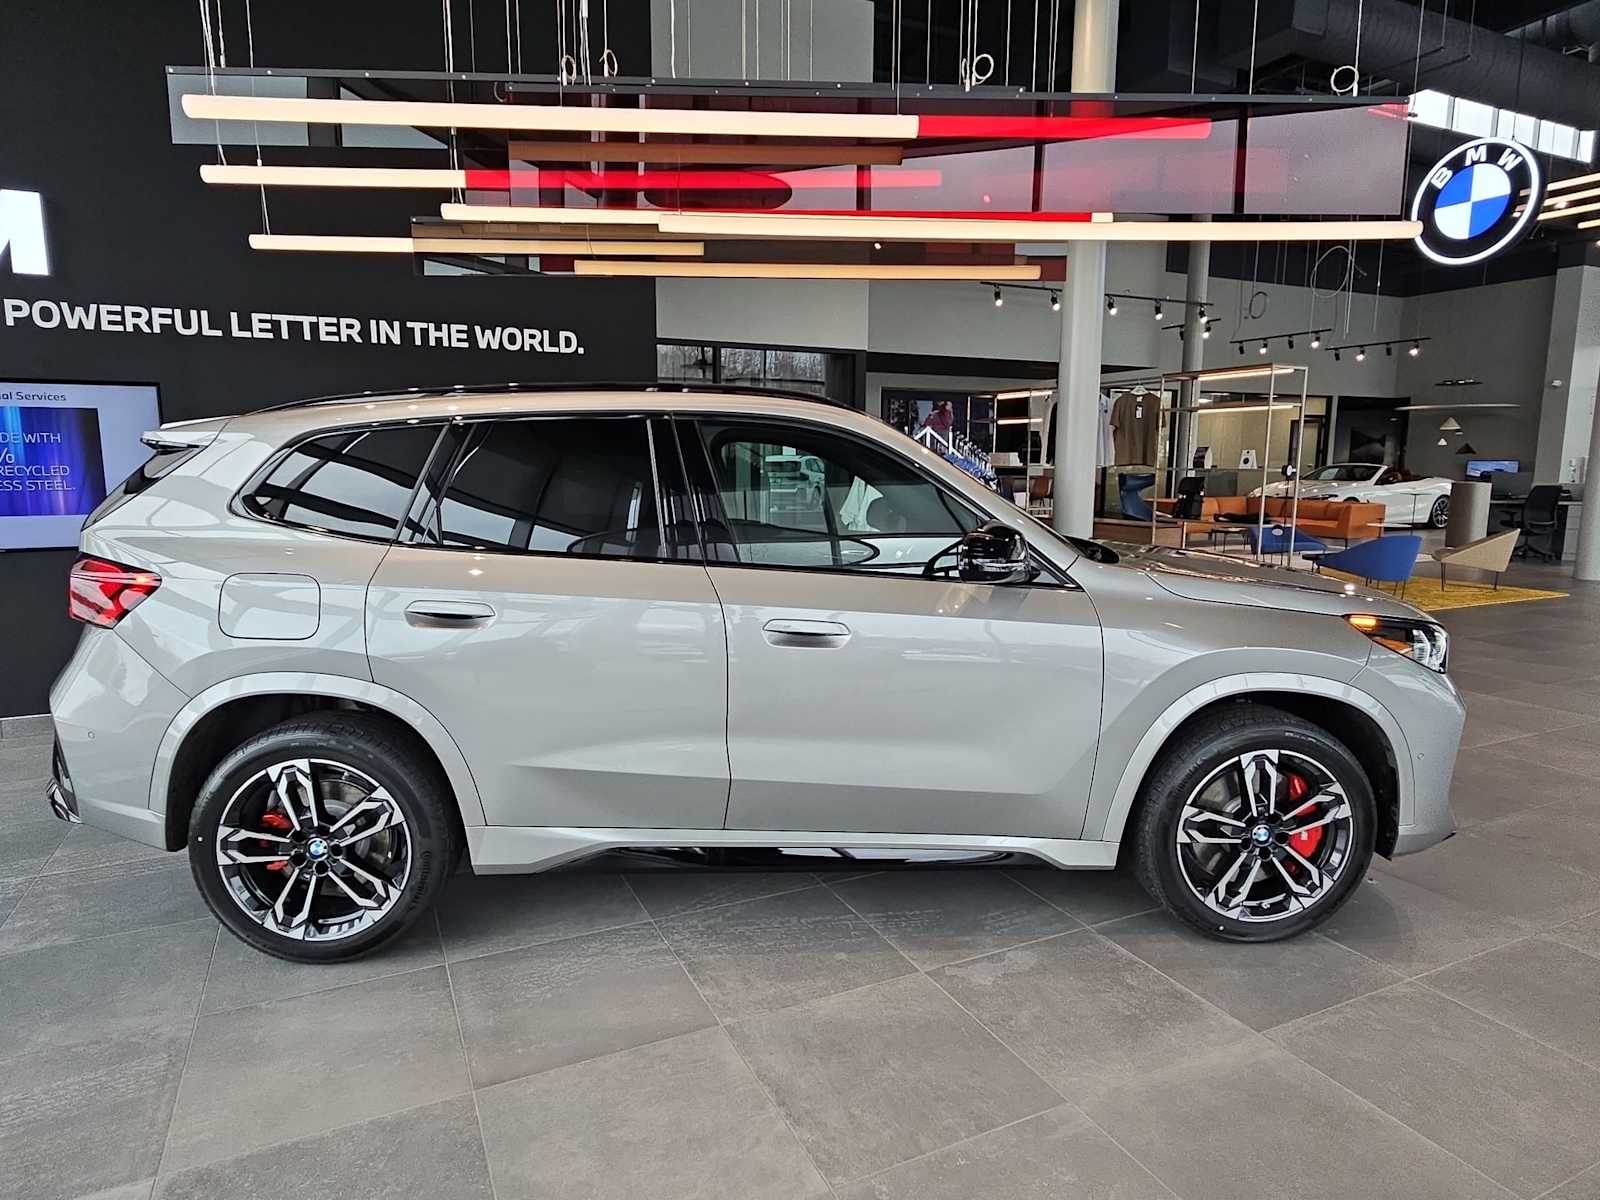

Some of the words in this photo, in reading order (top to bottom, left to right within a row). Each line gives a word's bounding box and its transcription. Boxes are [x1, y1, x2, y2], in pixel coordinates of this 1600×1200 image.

[1430, 145, 1523, 189] BMW
[4, 299, 223, 337] POWERFUL
[229, 311, 363, 343] LETTER
[370, 319, 400, 345] IN
[406, 322, 469, 348] THE
[474, 325, 585, 355] WORLD.
[0, 391, 13, 400] al
[15, 391, 67, 401] Services
[23, 432, 61, 443] WITH
[25, 480, 76, 491] STEEL.
